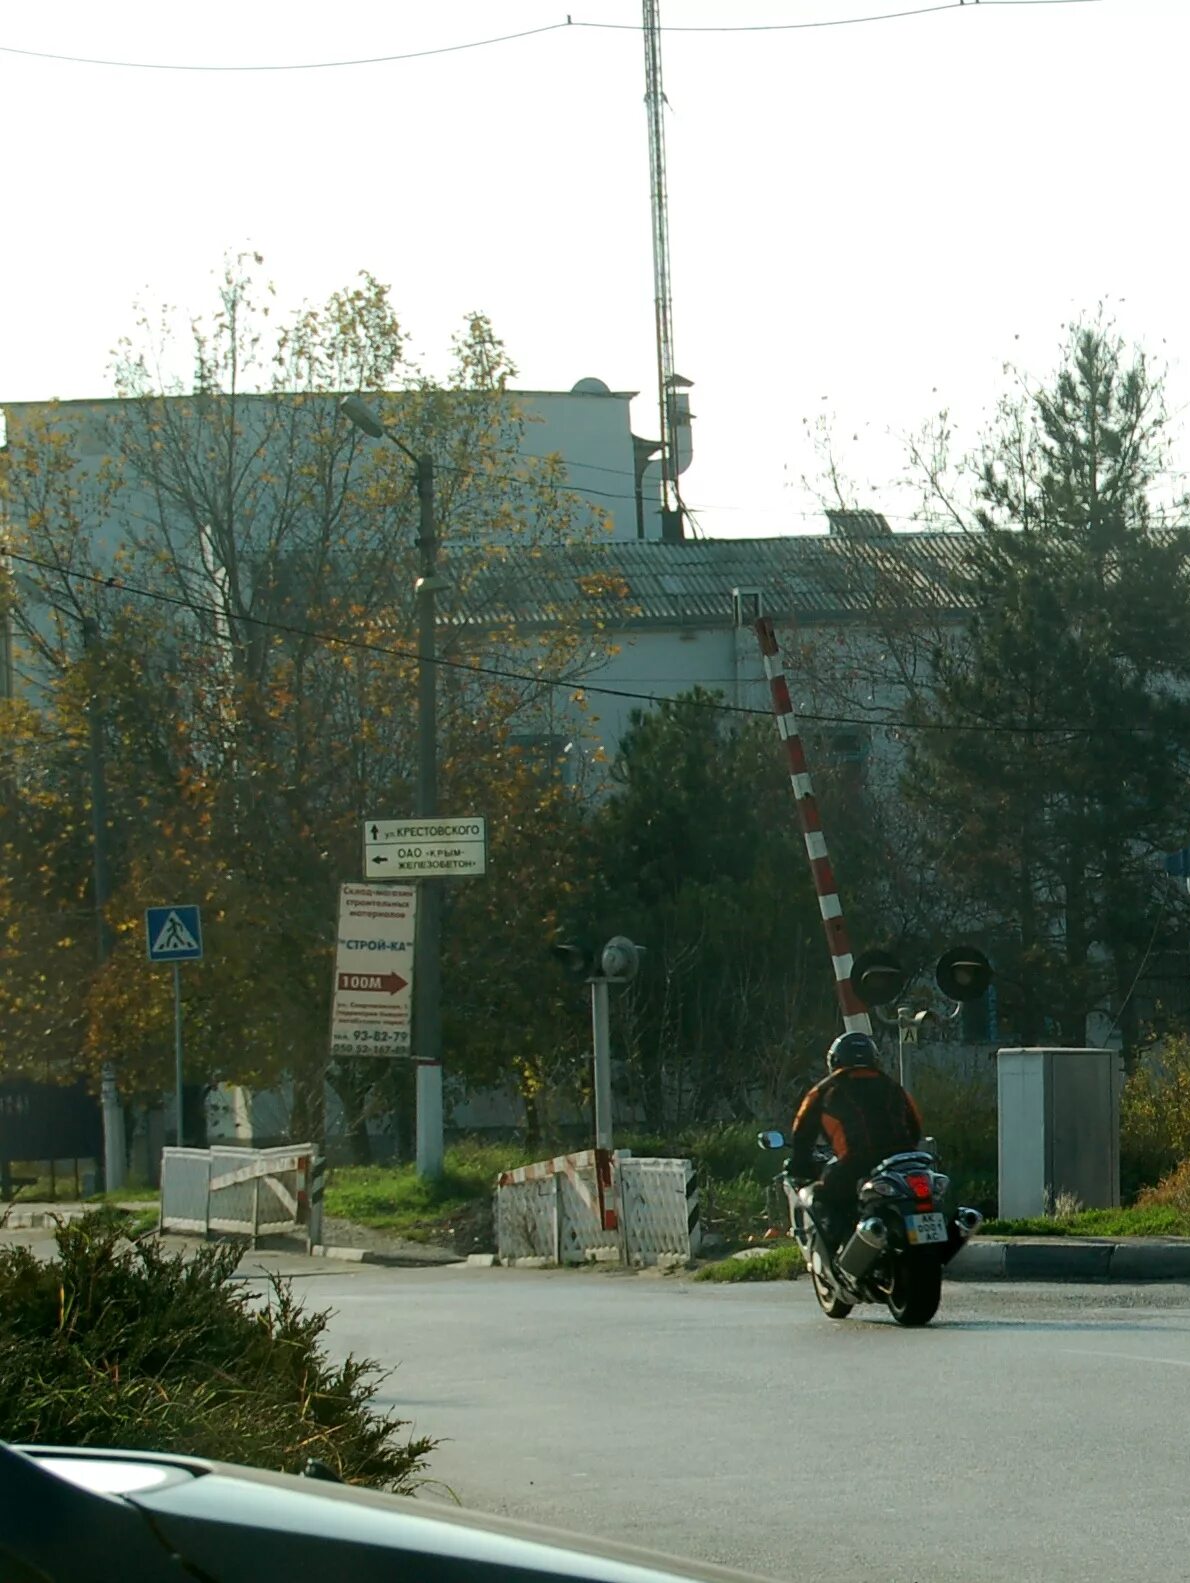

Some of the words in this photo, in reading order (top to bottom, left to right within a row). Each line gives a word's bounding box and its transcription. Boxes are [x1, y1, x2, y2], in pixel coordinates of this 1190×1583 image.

[397, 825, 480, 837] КРЕСТОВСКОГО
[397, 848, 422, 858] ОАО
[343, 976, 382, 989] 100М
